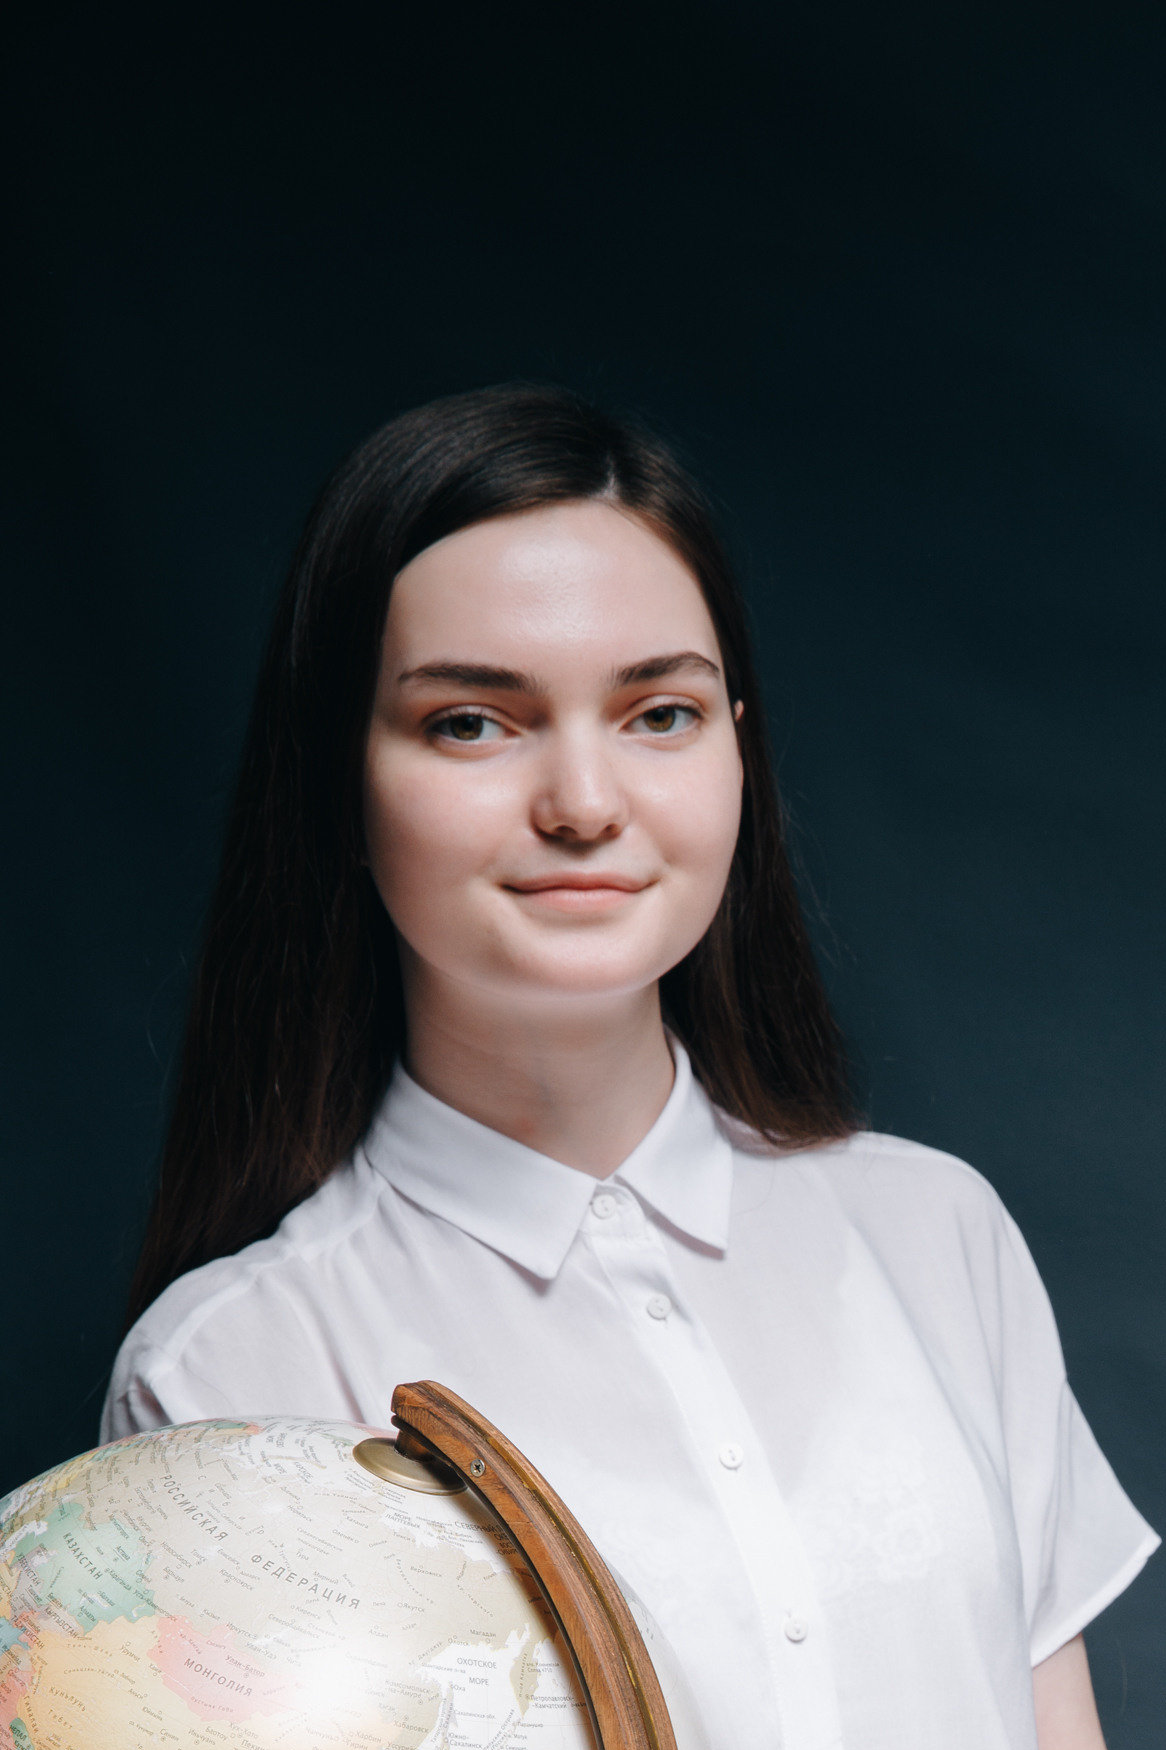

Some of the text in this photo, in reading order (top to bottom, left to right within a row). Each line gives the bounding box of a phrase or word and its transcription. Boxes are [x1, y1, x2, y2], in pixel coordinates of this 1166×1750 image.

[160, 1474, 229, 1541] РОССИЙСКАЯ
[251, 1554, 361, 1610] ФЕДЕРАЦИЯ
[161, 1541, 194, 1569] Новосибирск
[62, 1532, 104, 1581] КАЗАХСТАН
[219, 1568, 255, 1591] Красноярск
[184, 1657, 254, 1697] МОНГОЛИЯ
[456, 1657, 497, 1670] ОХОТСКОЕ
[468, 1676, 490, 1687] МОРЕ
